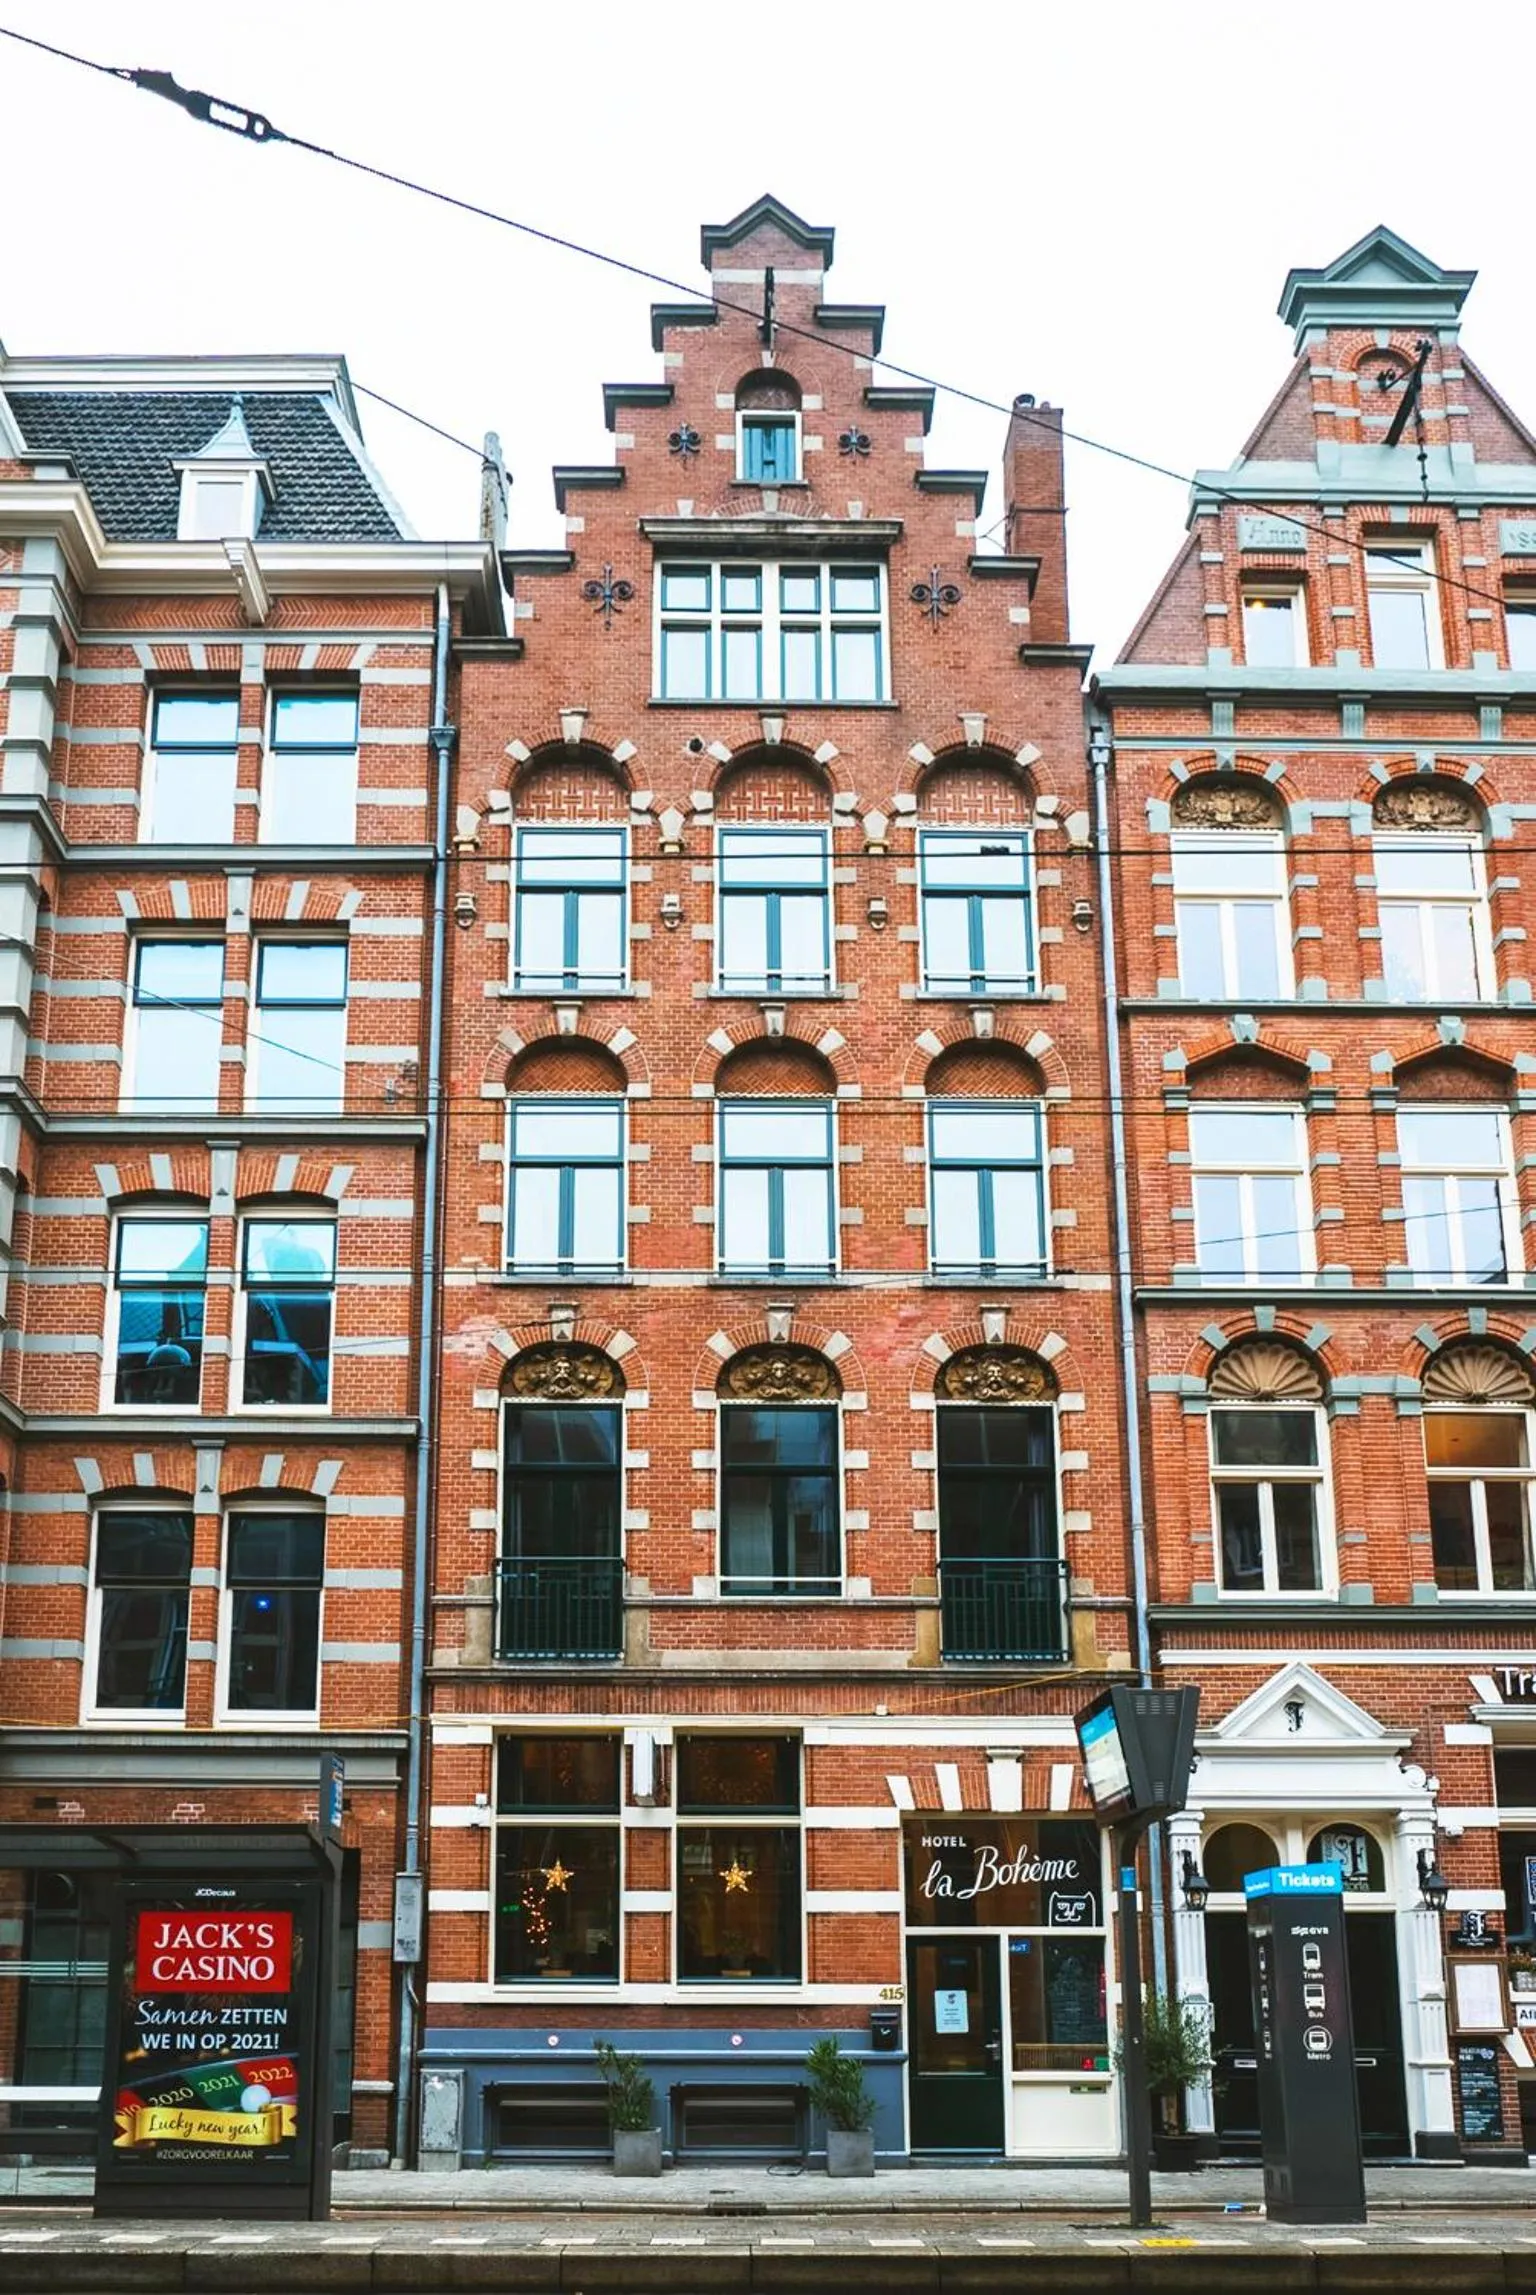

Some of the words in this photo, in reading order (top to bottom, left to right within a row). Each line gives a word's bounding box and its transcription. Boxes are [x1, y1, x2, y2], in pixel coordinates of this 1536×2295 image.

[921, 1836, 967, 1848] HOTEL
[920, 1860, 955, 1898] la
[957, 1844, 1080, 1899] Bohème
[1278, 1872, 1336, 1888] Tickets
[195, 1888, 236, 1897] JCDecaux
[153, 1923, 275, 1949] JACK'S
[152, 1955, 275, 1981] CASINO
[1303, 1971, 1324, 1980] Tram
[879, 1986, 904, 2000] 415
[134, 2000, 218, 2025] Samen
[220, 2008, 288, 2025] ZETTEN
[1308, 2010, 1324, 2019] Bus
[142, 2033, 171, 2050] WE
[176, 2033, 196, 2050] IN
[200, 2033, 227, 2050] OP
[231, 2033, 280, 2050] 2021!
[1306, 2052, 1332, 2061] Metro
[248, 2066, 294, 2084] 2022
[198, 2075, 240, 2093] 2021
[148, 2086, 194, 2108] 2020
[148, 2111, 194, 2138] Lucky
[197, 2122, 224, 2134] new
[228, 2117, 267, 2140] year!
